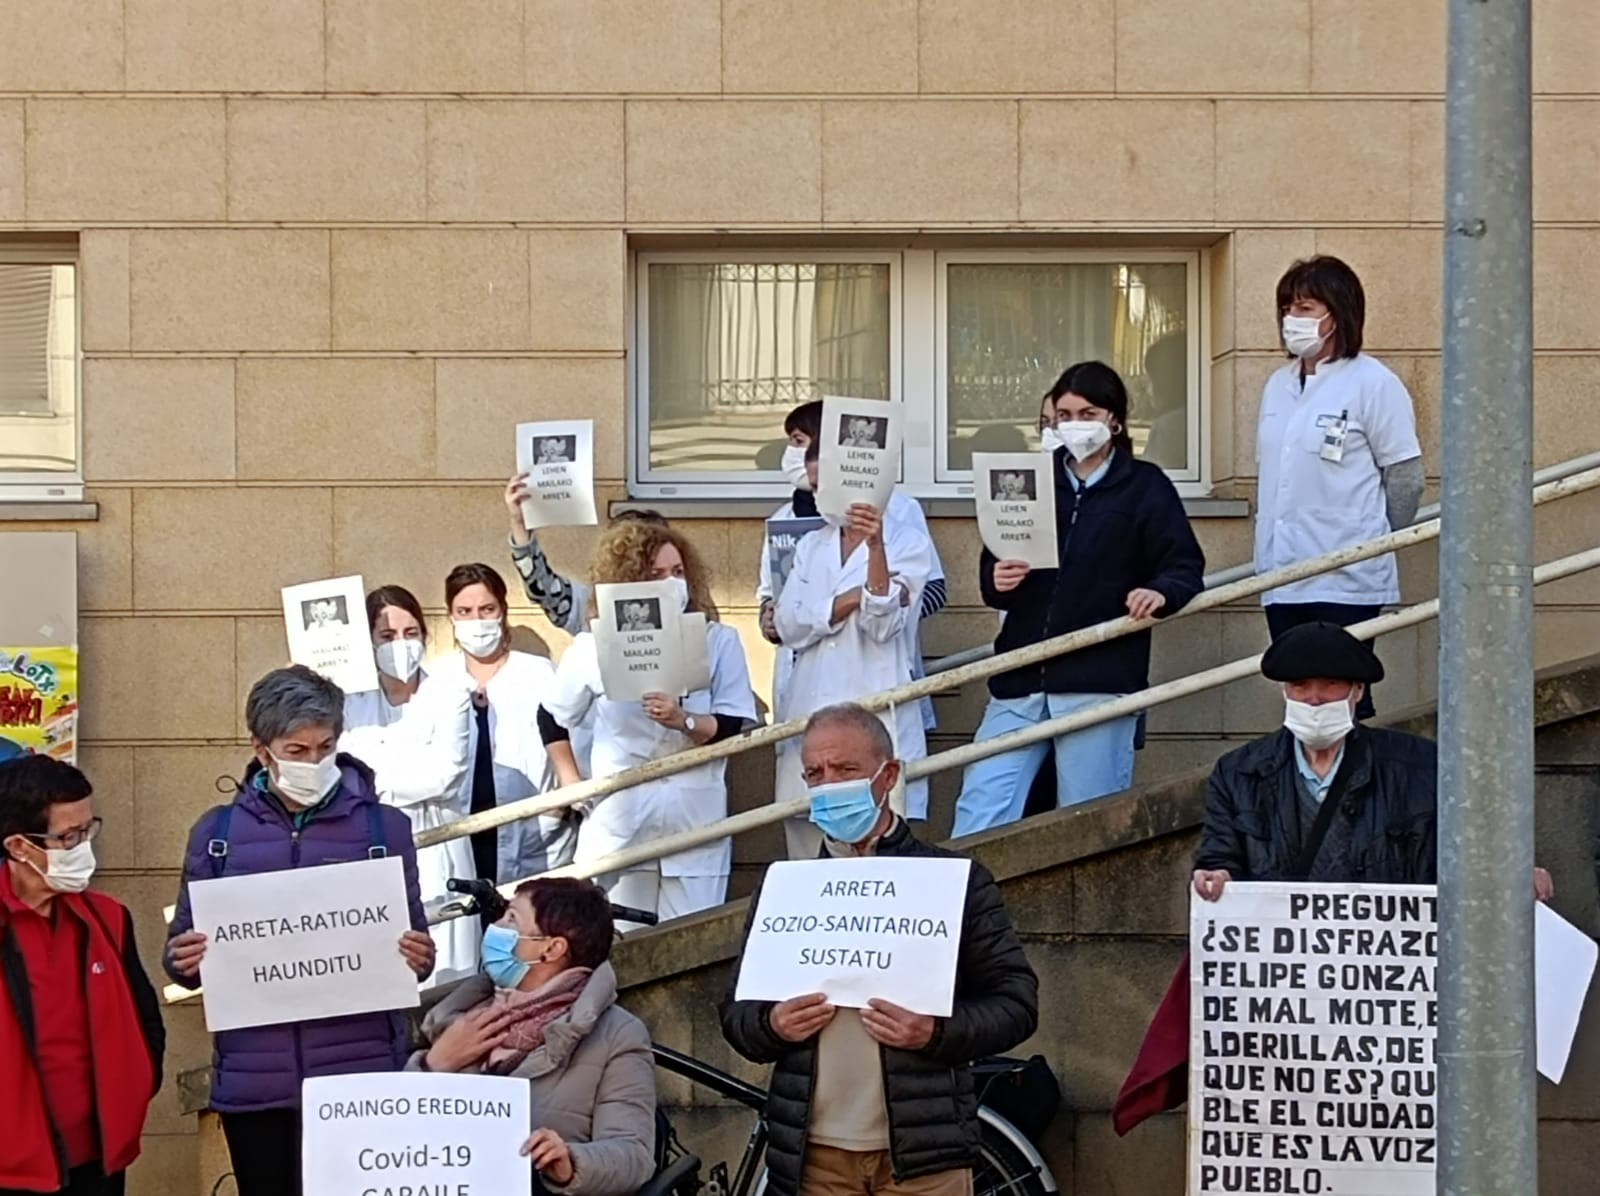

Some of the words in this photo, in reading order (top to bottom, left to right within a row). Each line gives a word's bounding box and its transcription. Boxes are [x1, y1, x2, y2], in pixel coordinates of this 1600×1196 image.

[847, 451, 875, 460] LEHEN
[542, 466, 567, 475] LEHEN
[840, 464, 880, 475] MAILAKO
[537, 478, 573, 488] MAILAKO
[841, 479, 875, 489] ARRETA
[542, 491, 571, 500] ARRETA
[1000, 505, 1027, 513] LEHEN
[996, 519, 1034, 527] MAILAKO
[1000, 533, 1032, 541] ARRETA
[627, 634, 654, 643] LEHEN
[623, 648, 661, 657] MAILAKO
[628, 663, 660, 672] ARRETA
[820, 880, 896, 897] ARRETA
[214, 905, 389, 943] ARRETA-RATIOAK
[760, 915, 948, 938] SOZIO-SANITARIOA
[1202, 920, 1260, 952] ¿SE
[799, 948, 892, 969] SUSTATU
[253, 954, 361, 983] HAUNDITU
[1202, 961, 1307, 989] FELIPE
[1318, 964, 1437, 992] GONZA
[1203, 996, 1238, 1022] DE
[1248, 997, 1315, 1024] MAL
[1203, 1064, 1265, 1091] QUE
[1274, 1066, 1315, 1093] NO
[1324, 1069, 1384, 1099] ES?
[319, 1097, 410, 1121] ORAINGO
[417, 1098, 511, 1118] EREDUAN
[1203, 1097, 1259, 1124] BLE
[1270, 1100, 1306, 1126] EL
[1316, 1101, 1435, 1129] CIUDAD
[1202, 1130, 1263, 1158] QUE
[1272, 1134, 1313, 1160] ES
[358, 1144, 471, 1171] Covid-19
[1200, 1165, 1332, 1194] PUEBLO.
